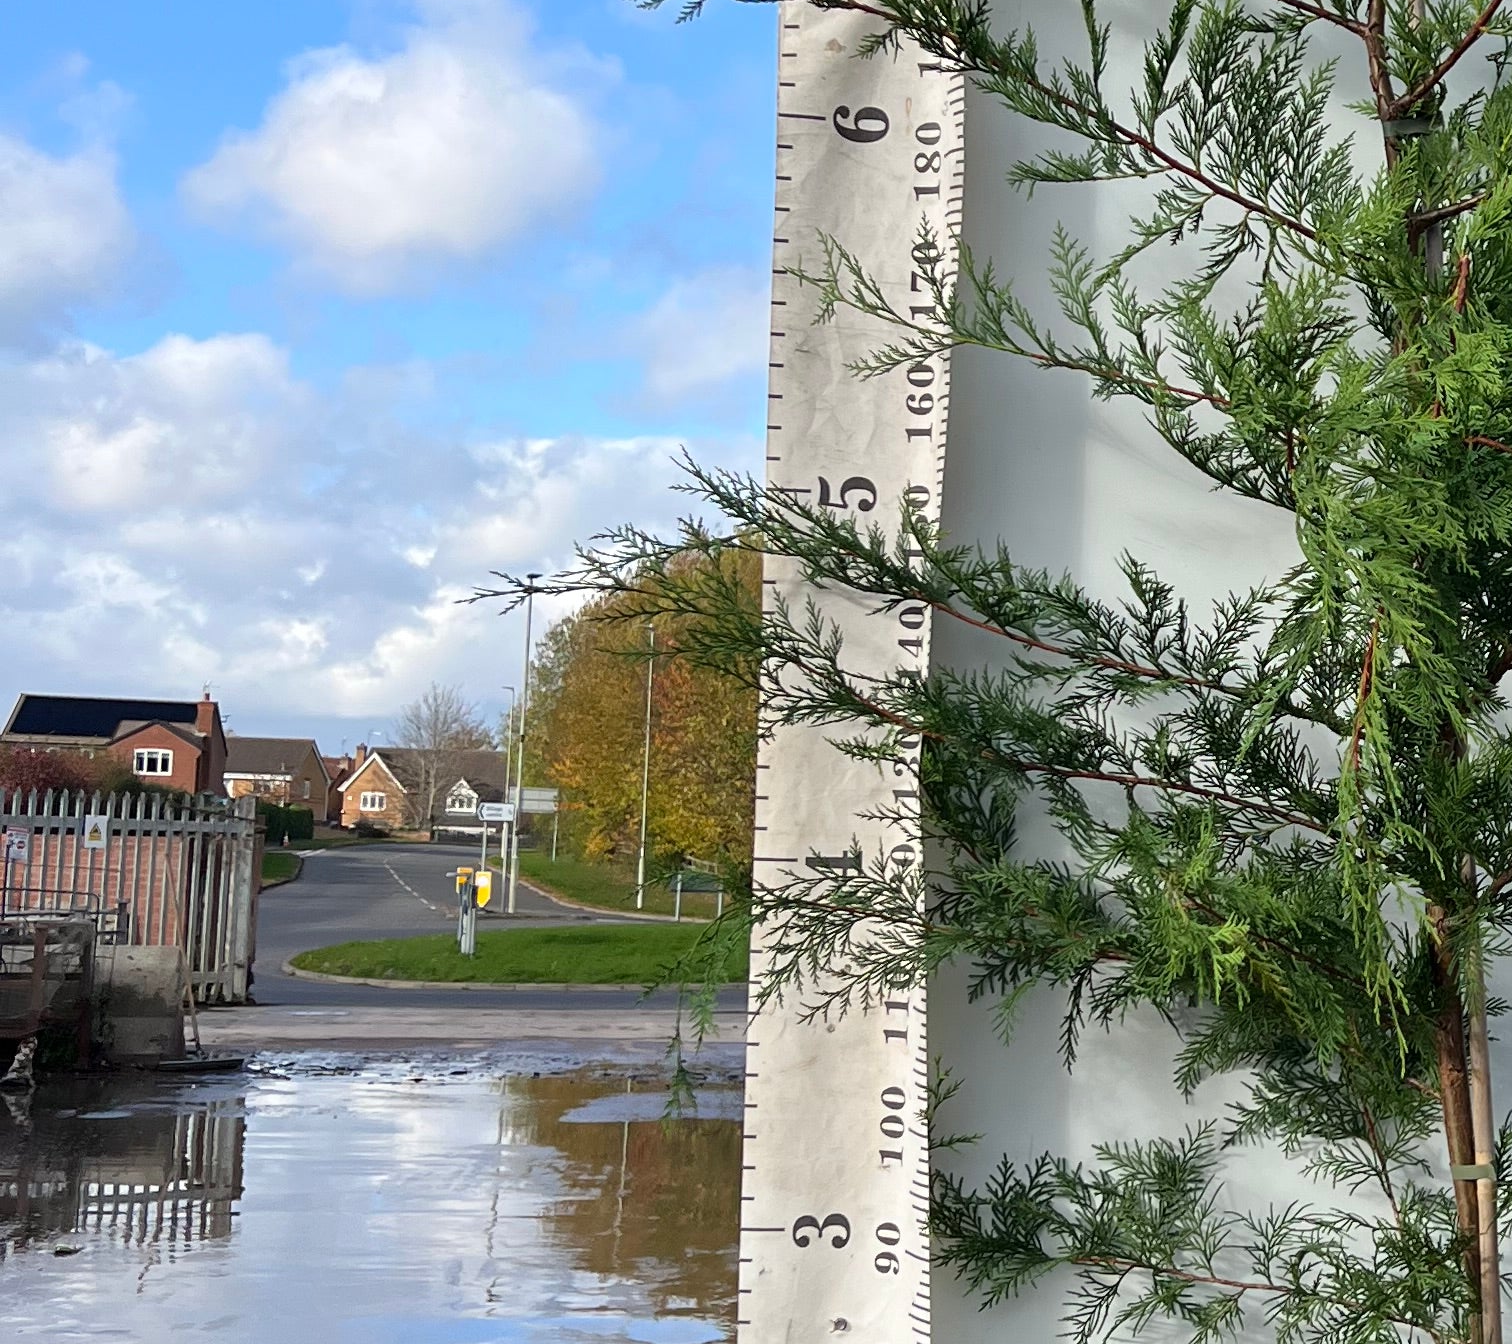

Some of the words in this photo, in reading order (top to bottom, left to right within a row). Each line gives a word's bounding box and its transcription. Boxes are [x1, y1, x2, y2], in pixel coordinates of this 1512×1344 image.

[833, 105, 890, 144] 6
[914, 121, 942, 202] 180
[909, 241, 941, 321] 170
[905, 362, 936, 444] 160
[818, 475, 877, 513] 5
[896, 606, 924, 689] 140
[805, 850, 863, 886] 4
[878, 1086, 906, 1166] 100
[792, 1213, 851, 1249] 3
[874, 1221, 901, 1276] 90
